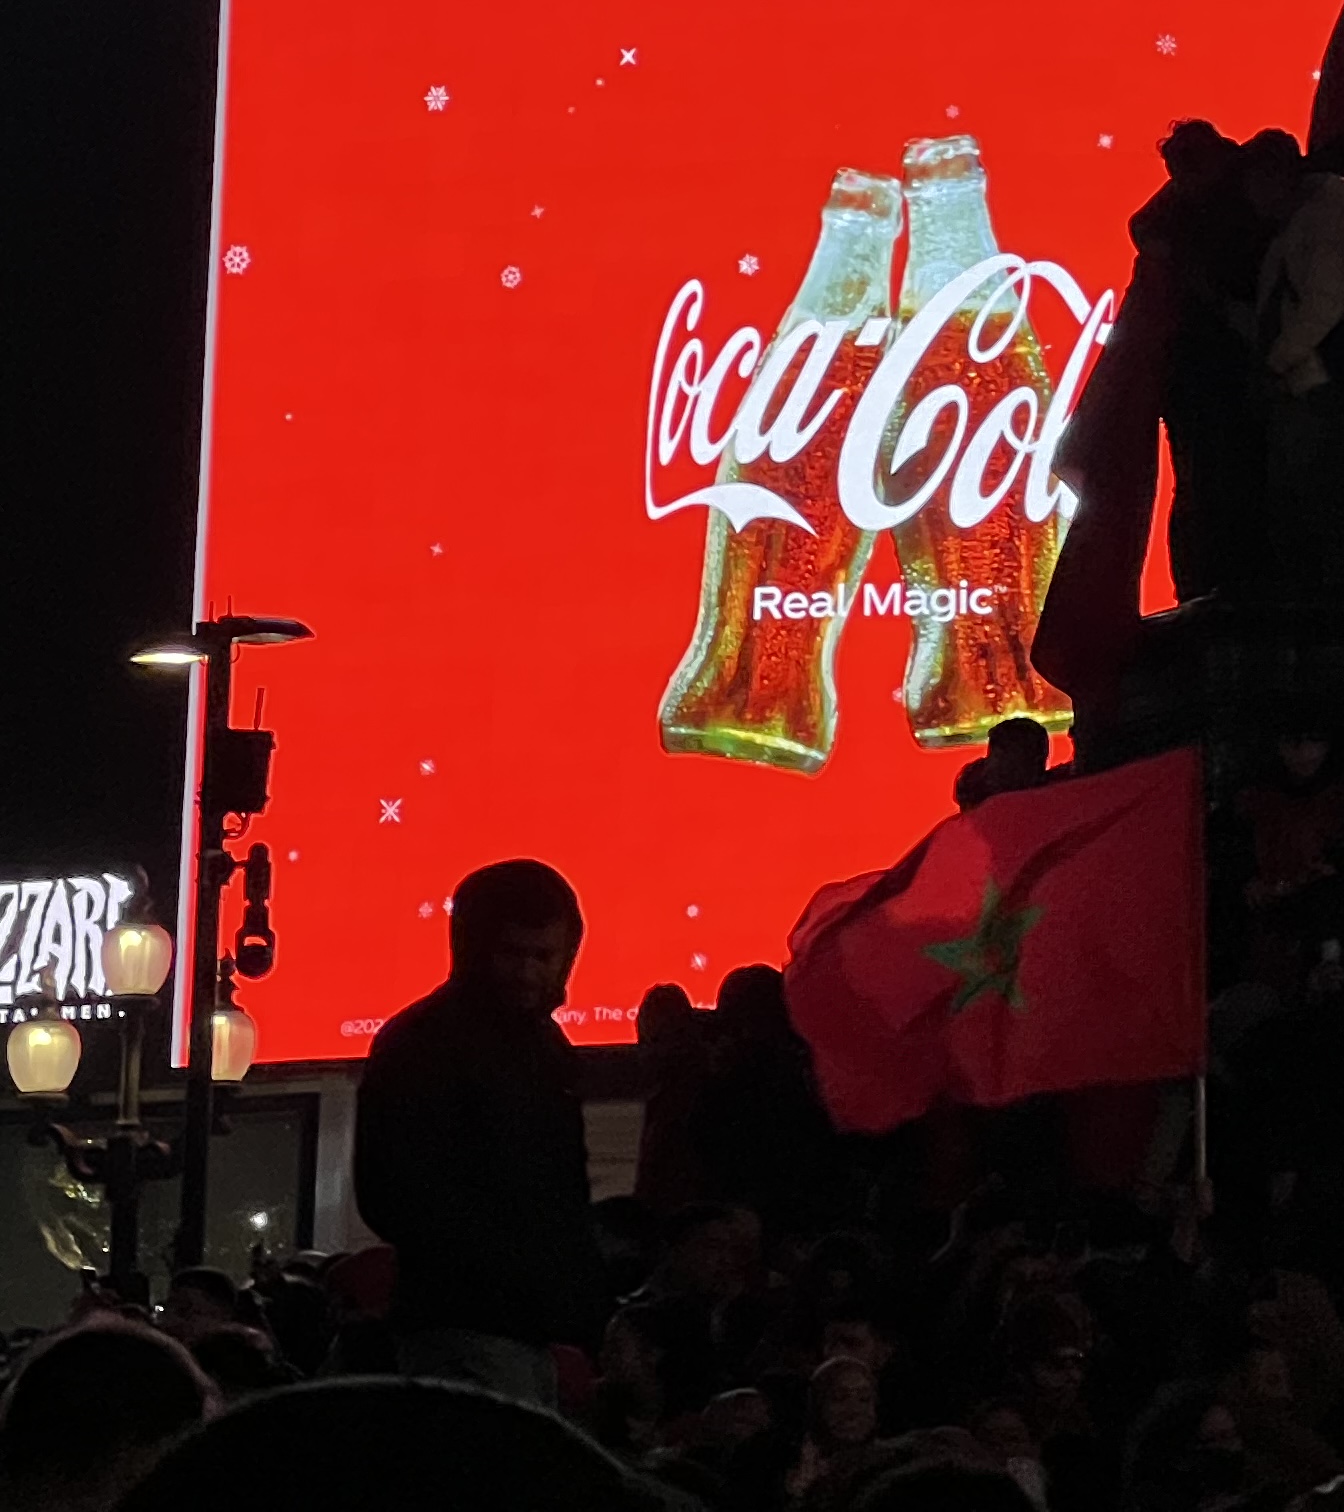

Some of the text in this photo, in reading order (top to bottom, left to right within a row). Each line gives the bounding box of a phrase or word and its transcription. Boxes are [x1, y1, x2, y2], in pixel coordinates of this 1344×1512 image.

[645, 252, 1116, 539] Coca-Col
[752, 582, 849, 621] Real
[594, 1006, 623, 1022] The
